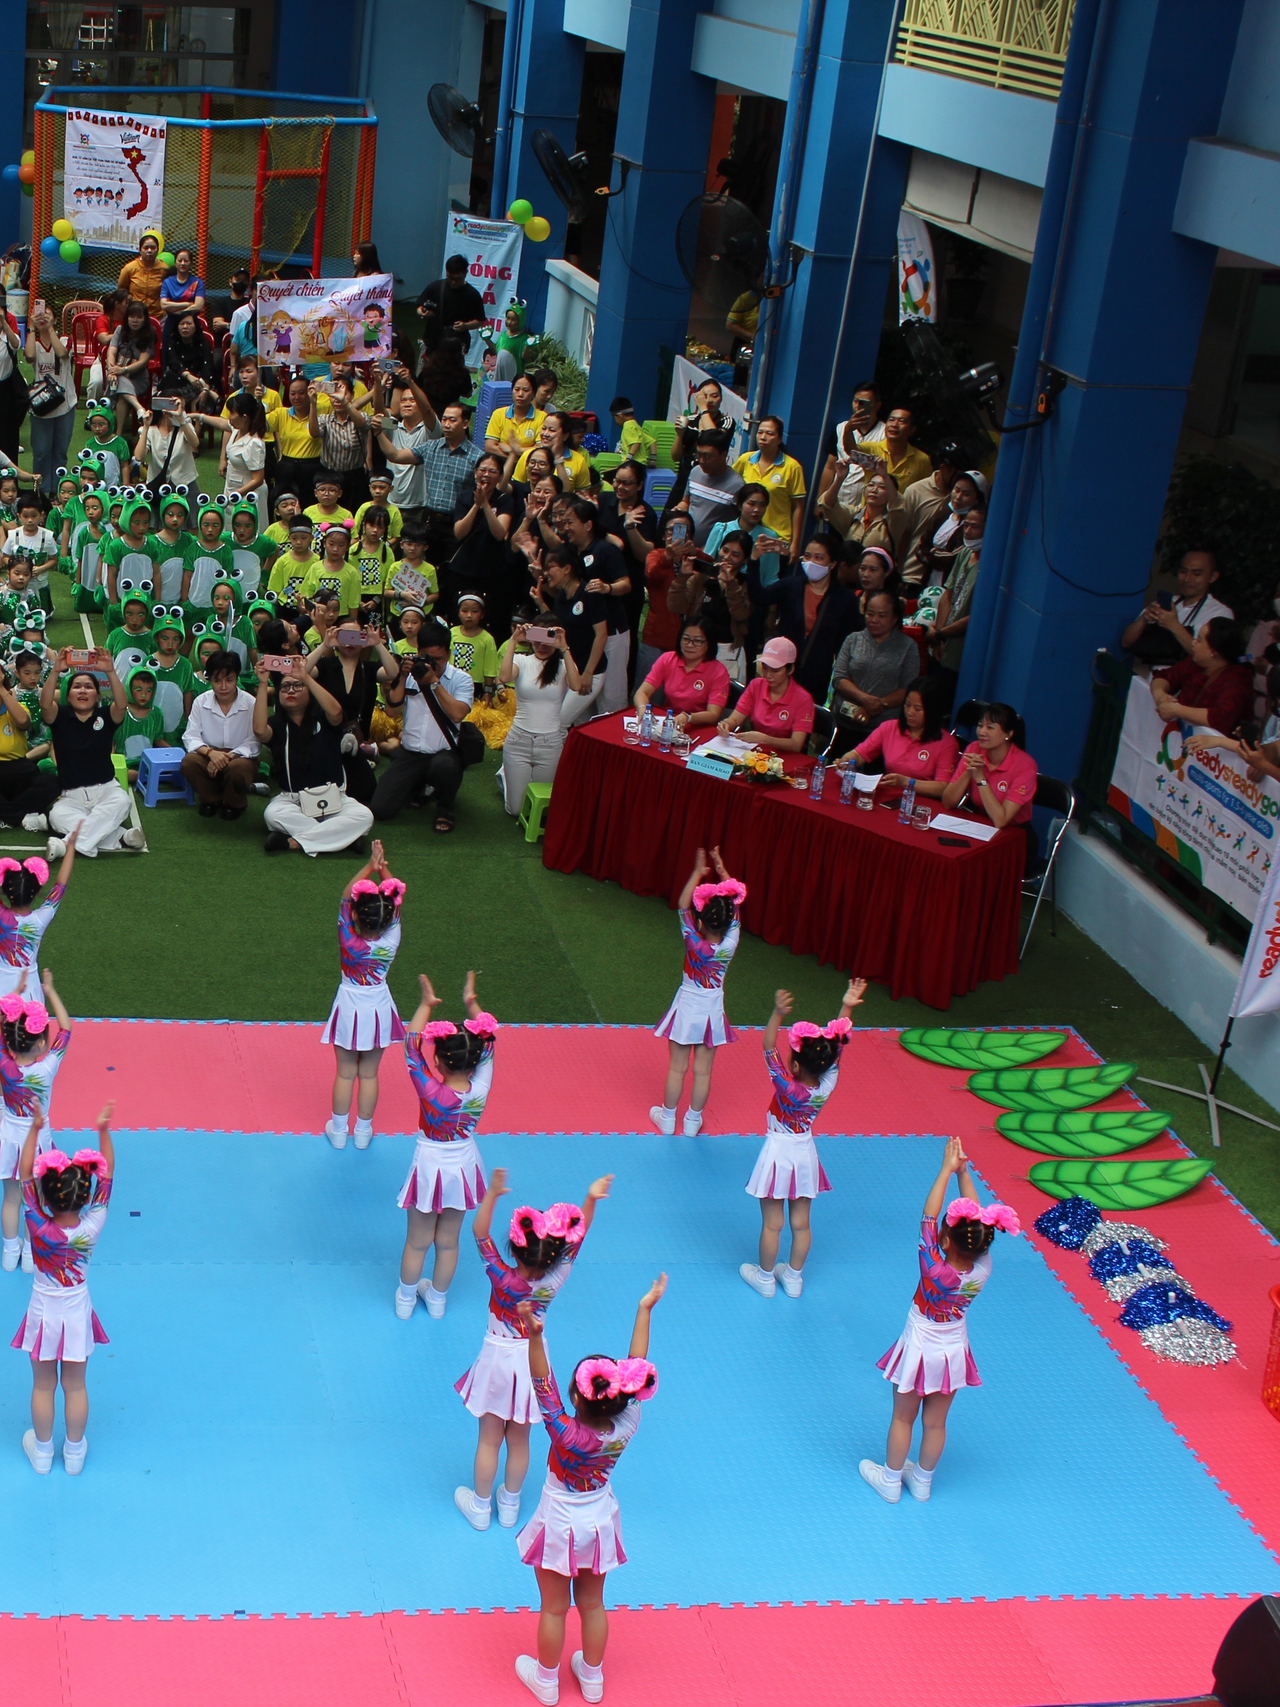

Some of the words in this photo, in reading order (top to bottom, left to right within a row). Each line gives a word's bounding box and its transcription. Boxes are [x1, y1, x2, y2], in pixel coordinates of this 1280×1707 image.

[467, 255, 512, 281] ÓNG
[258, 282, 294, 303] Quyết
[295, 282, 325, 297] chiến
[453, 642, 475, 671] B
[1189, 748, 1280, 820] eadysteadygo
